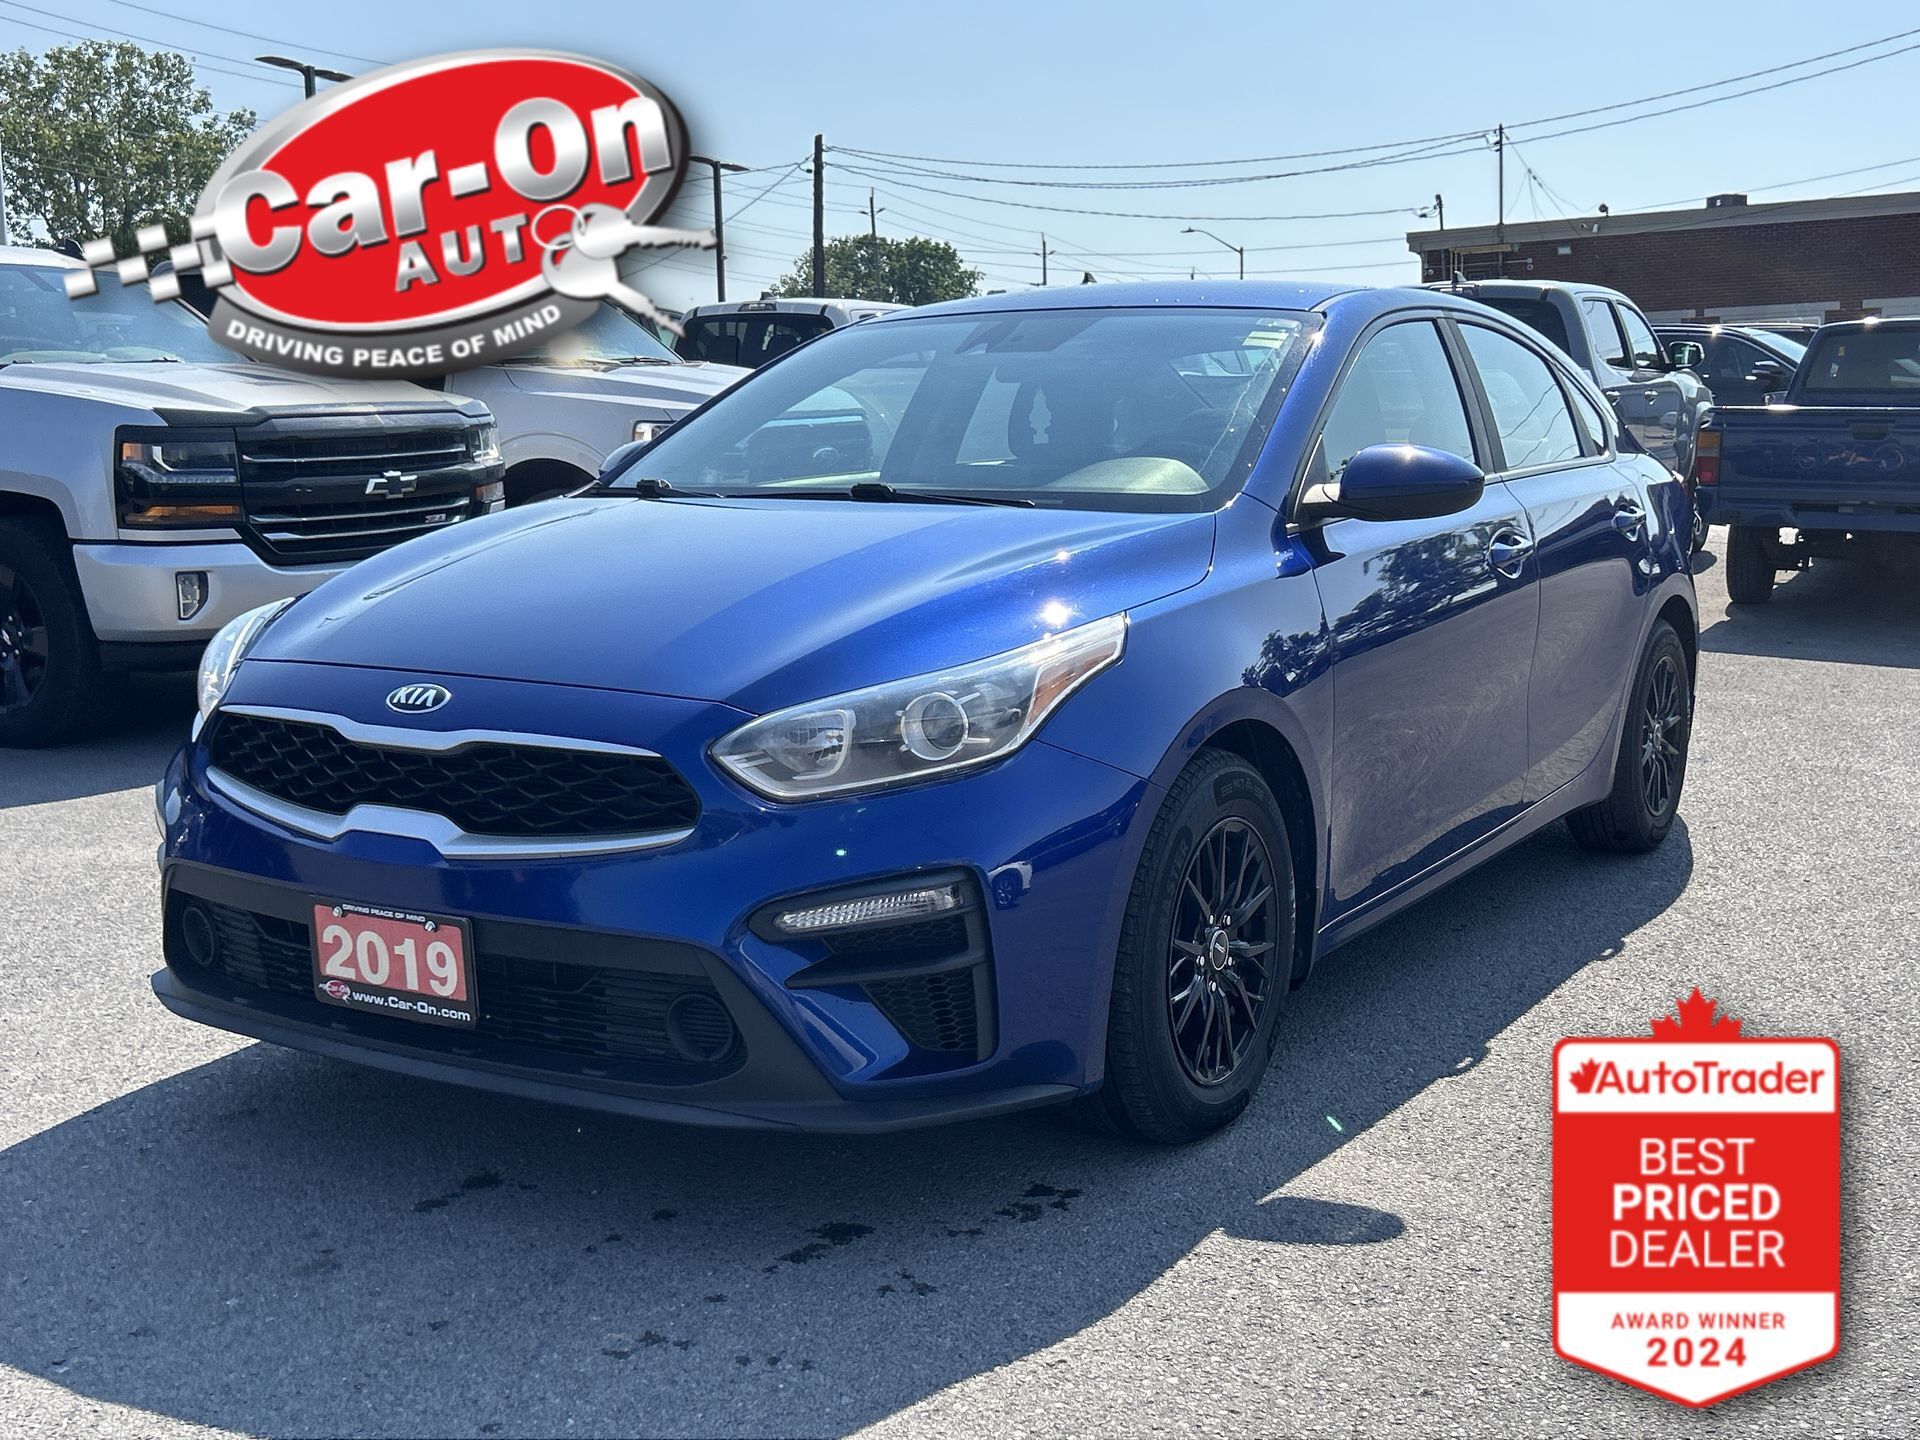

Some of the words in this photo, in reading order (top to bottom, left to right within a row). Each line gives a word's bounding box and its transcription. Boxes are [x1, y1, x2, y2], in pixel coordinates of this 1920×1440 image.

[392, 686, 438, 707] KIA
[370, 908, 394, 918] PEACE
[406, 913, 426, 923] MIND
[322, 924, 458, 997] 2019
[352, 991, 471, 1022] www.Car-On.com
